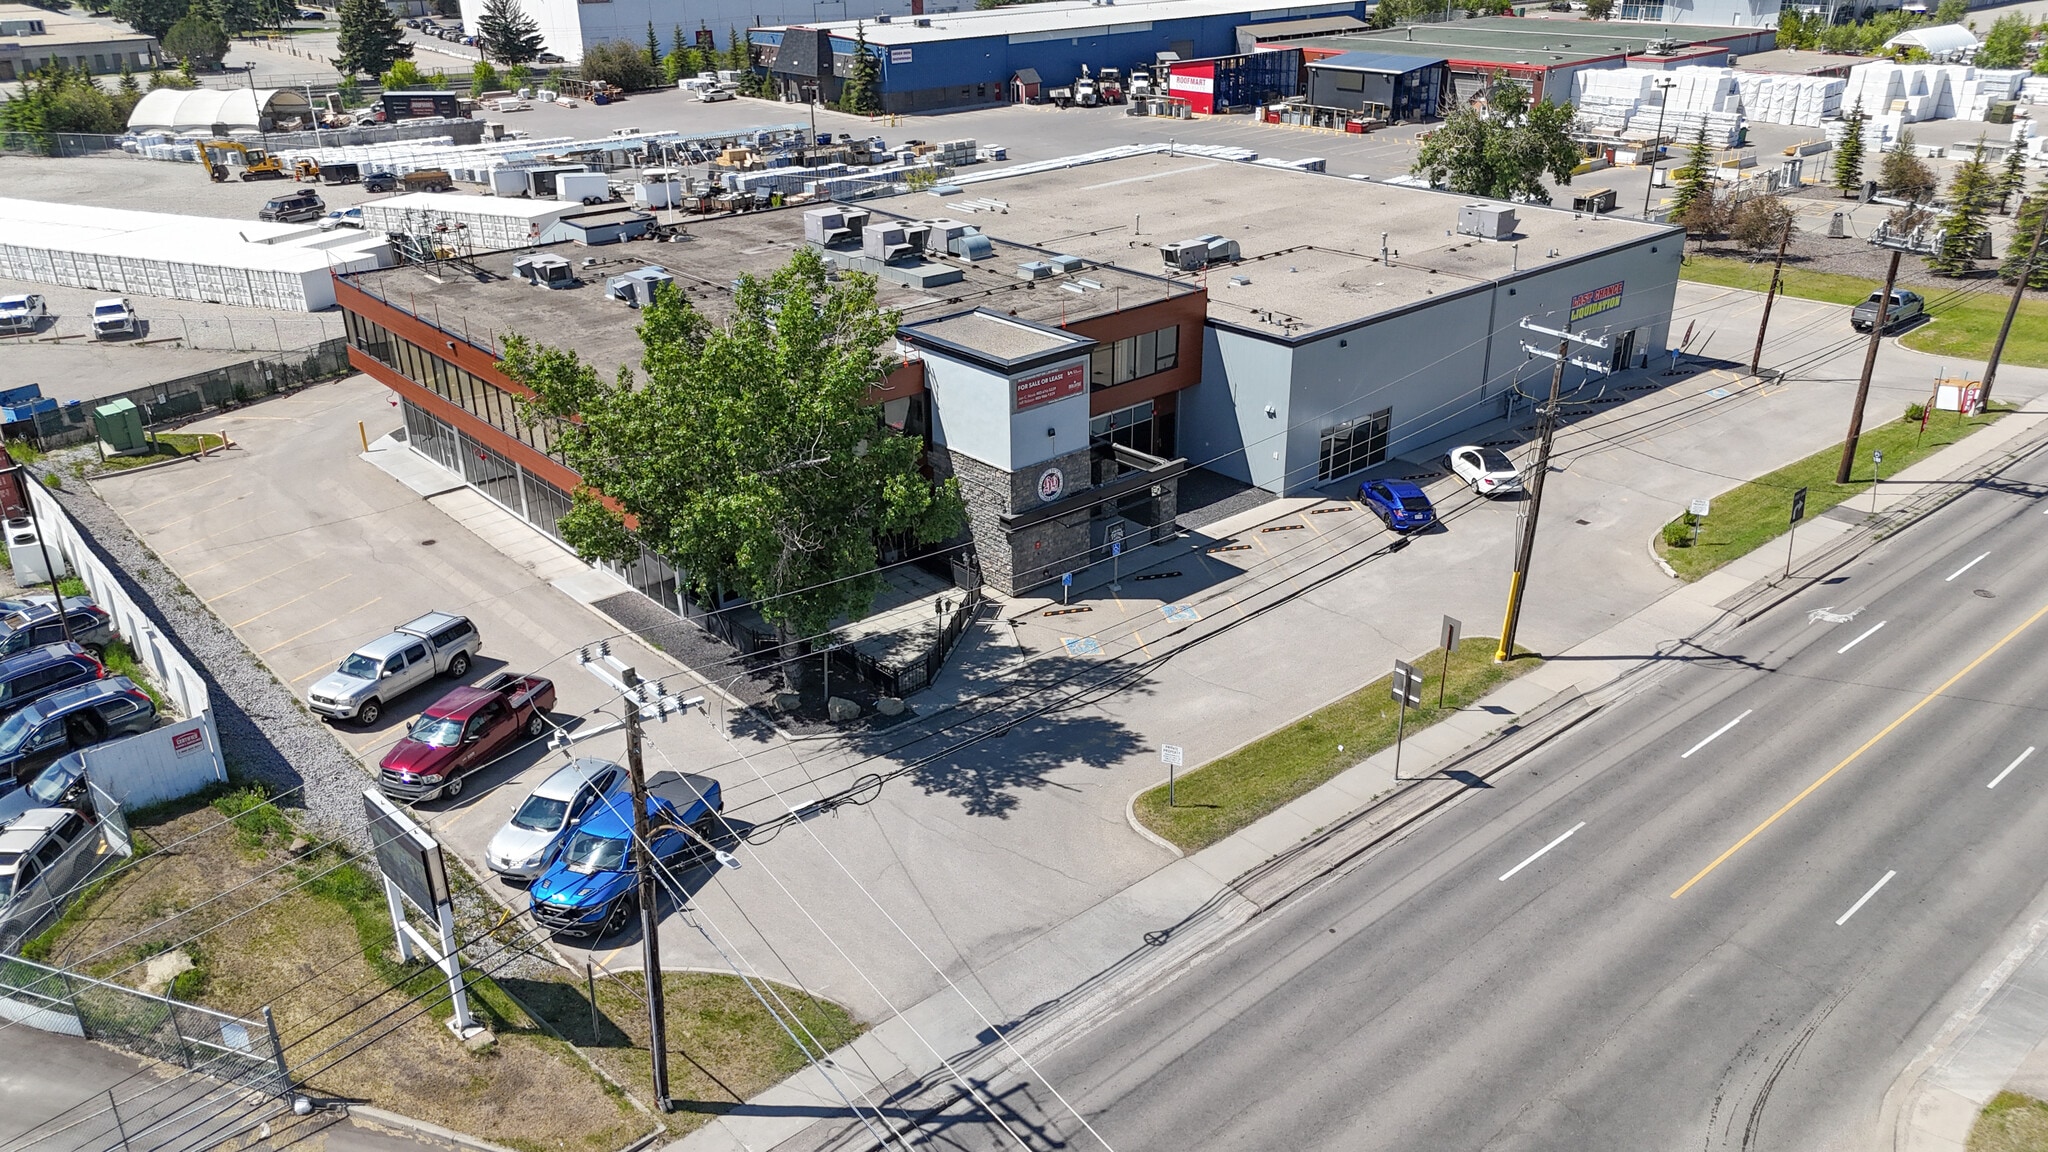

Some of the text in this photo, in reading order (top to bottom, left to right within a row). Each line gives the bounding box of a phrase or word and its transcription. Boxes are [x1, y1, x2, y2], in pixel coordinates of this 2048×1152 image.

[1176, 76, 1206, 86] ROOFMART
[1572, 282, 1623, 309] LAST CHANCE
[1570, 294, 1621, 321] LIQUIDATION
[1017, 383, 1028, 392] FOR
[1028, 379, 1041, 389] SALE
[1041, 377, 1049, 385] OR
[1049, 373, 1064, 383] LEASE
